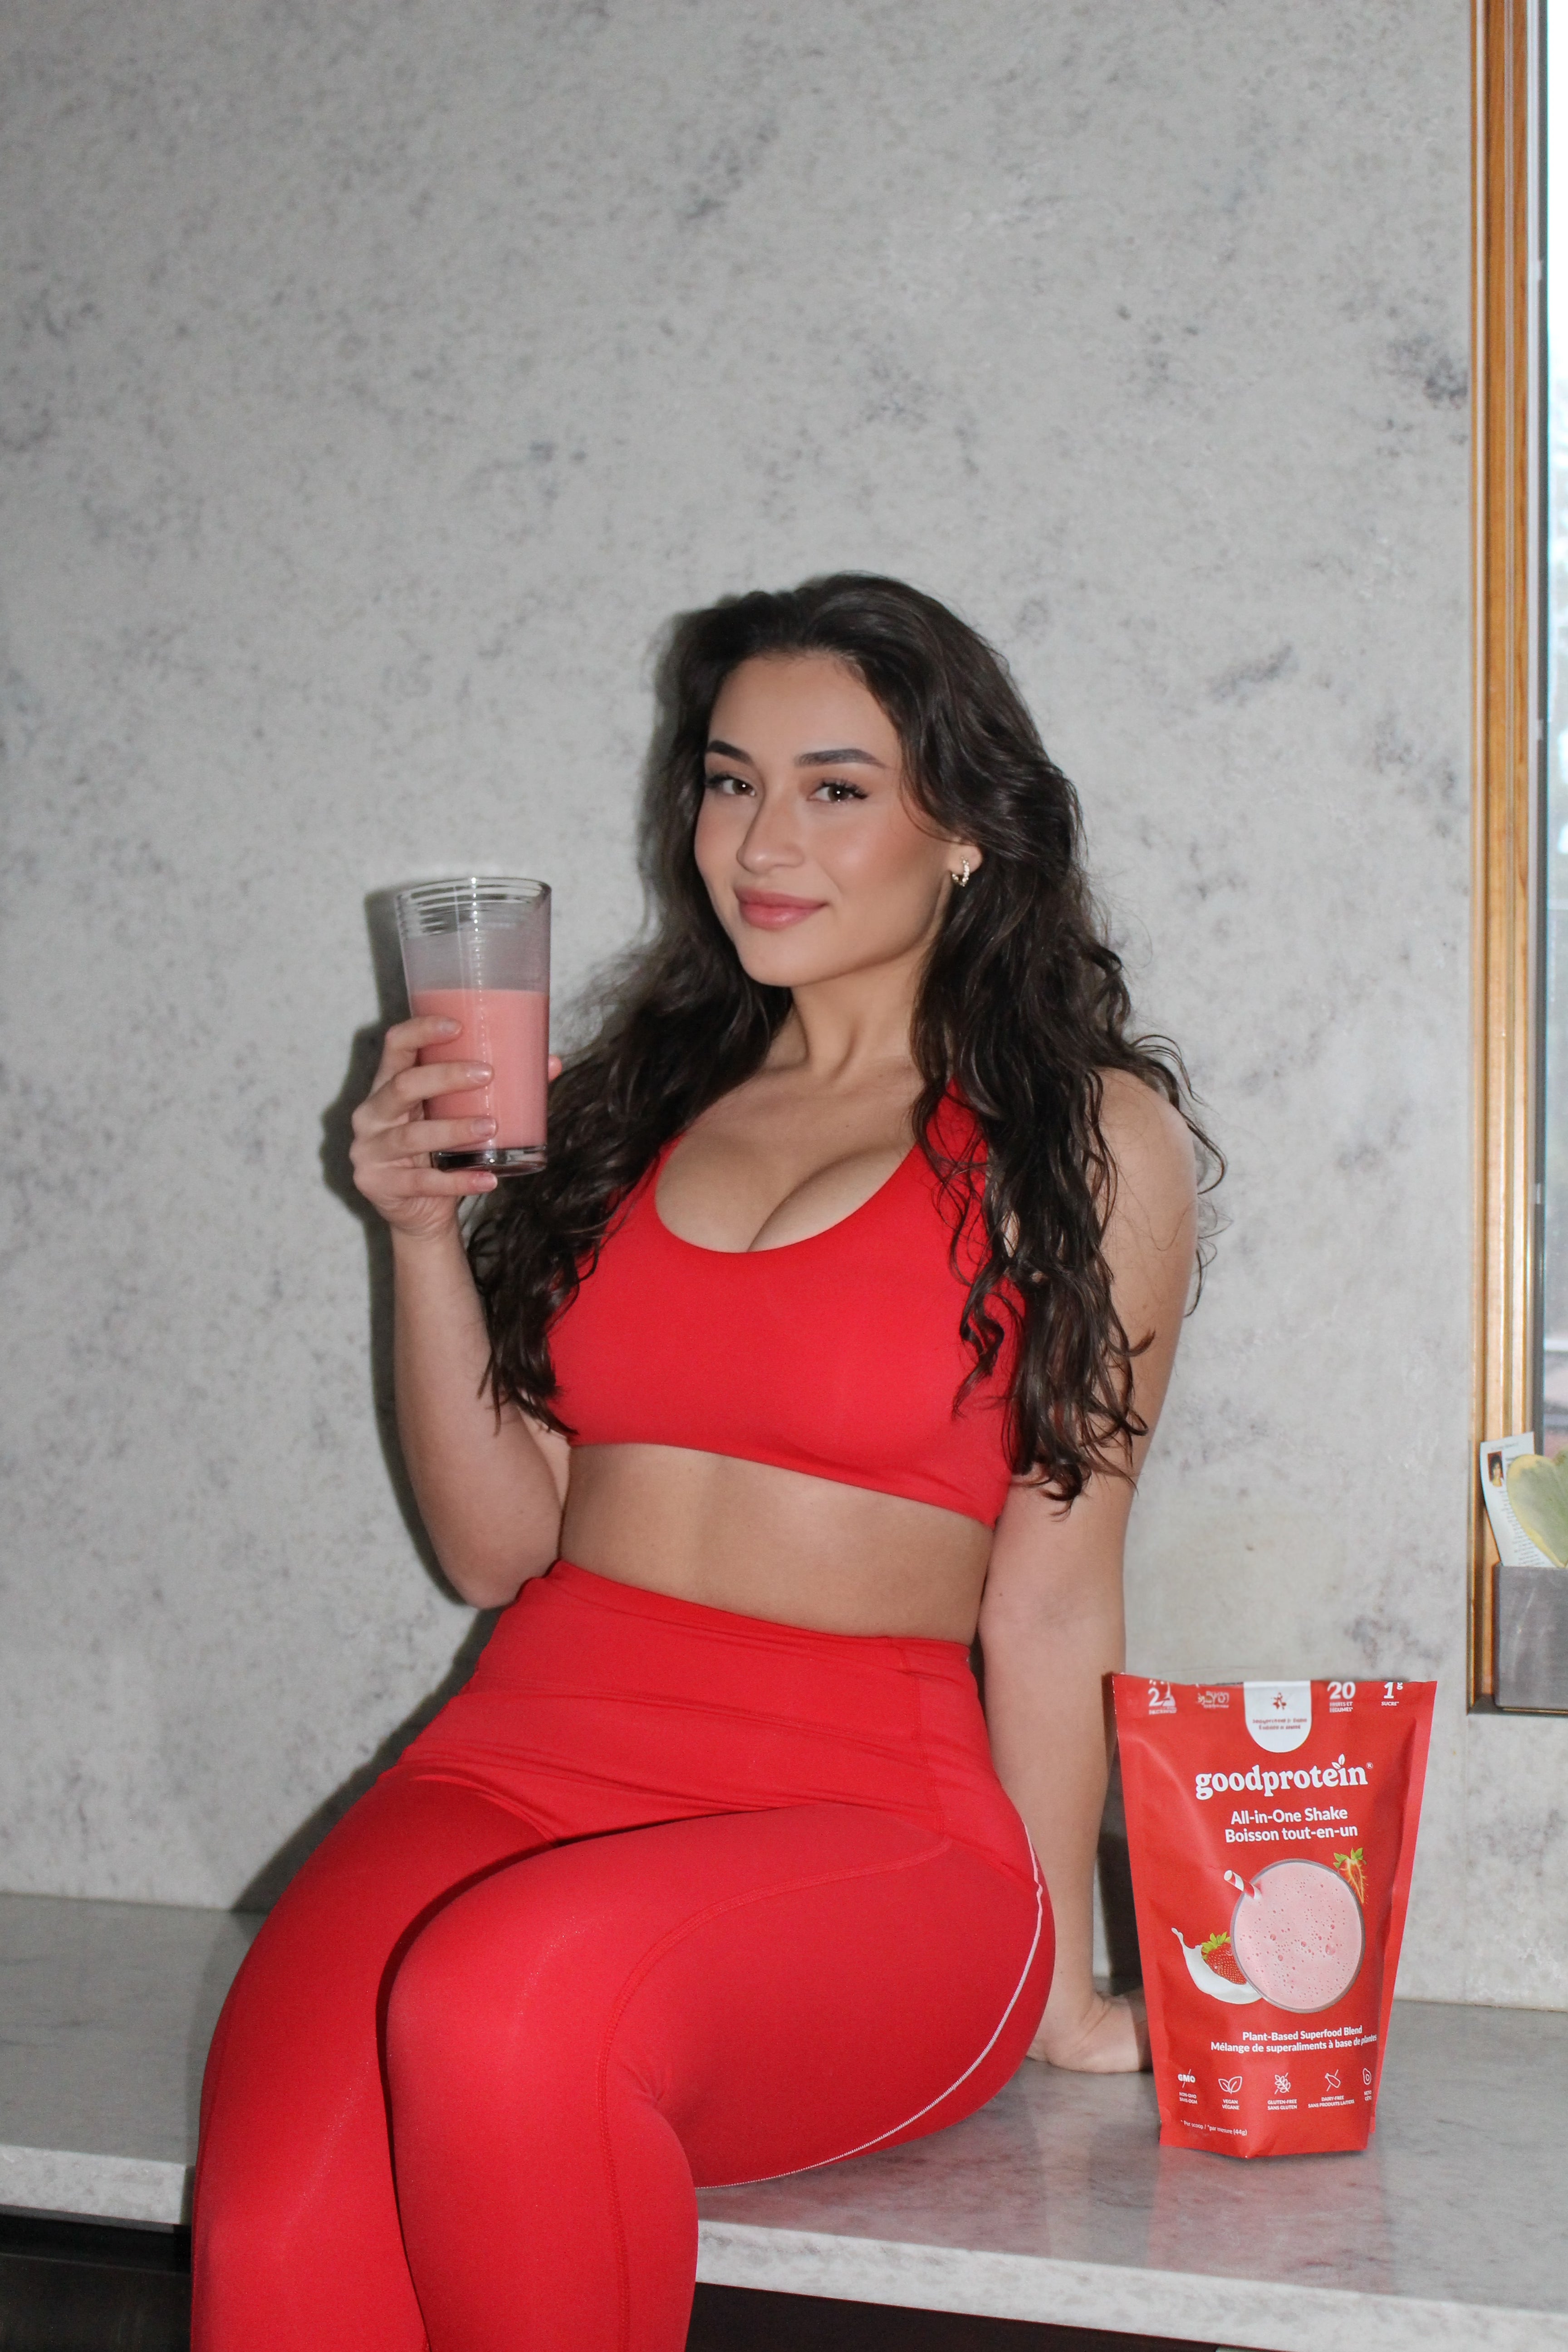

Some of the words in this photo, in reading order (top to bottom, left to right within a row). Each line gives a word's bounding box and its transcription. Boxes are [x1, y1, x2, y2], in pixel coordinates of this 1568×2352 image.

[1327, 1682, 1356, 1700] 20
[1231, 1808, 1302, 1824] All-in-One
[1304, 1806, 1348, 1821] Shake
[1225, 1828, 1279, 1842] Boisson
[1282, 1826, 1357, 1839] tout-en-un
[1243, 2030, 1298, 2041] Plant-Based
[1300, 2028, 1342, 2039] Superfood
[1344, 2025, 1362, 2035] Blend
[1211, 2042, 1250, 2053] Mélange
[1252, 2043, 1264, 2052] de
[1266, 2042, 1327, 2053] superaliments
[1328, 2040, 1333, 2048] à
[1335, 2039, 1352, 2048] base
[1361, 2034, 1377, 2046] plantes
[1177, 2074, 1196, 2083] GMO
